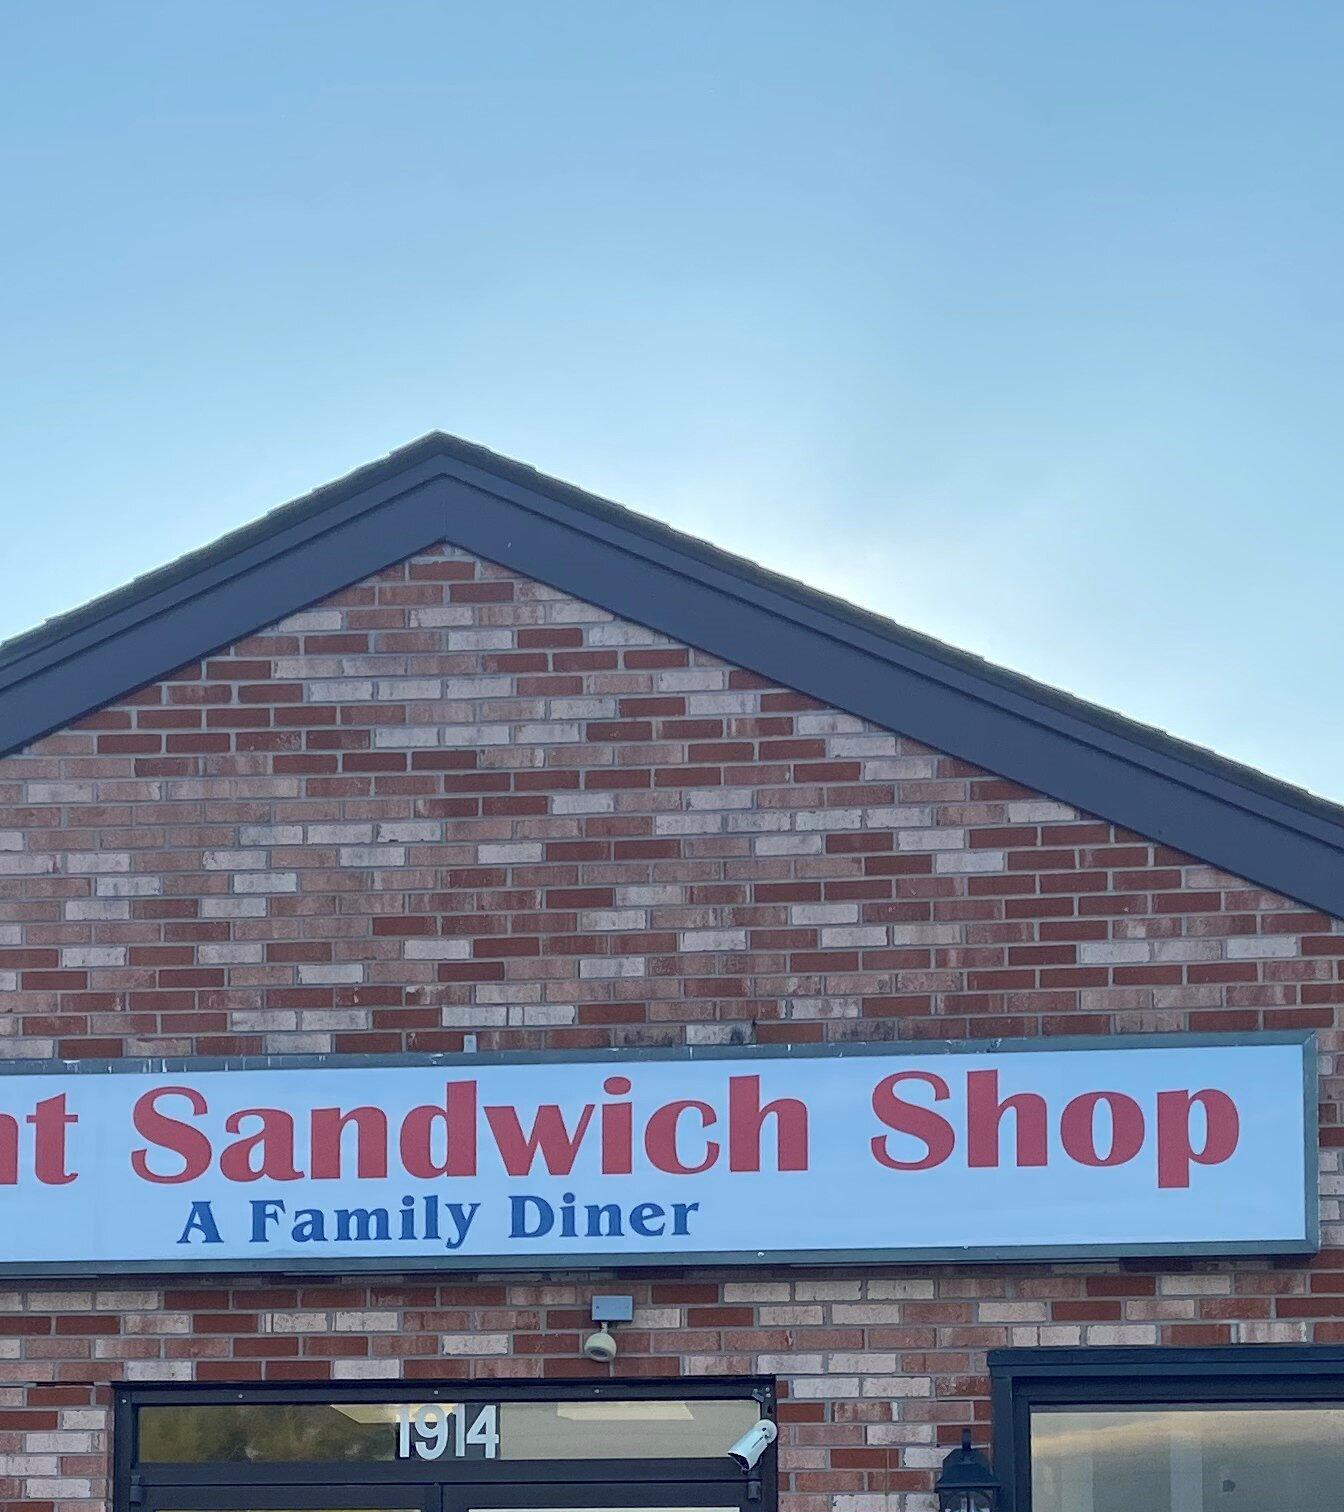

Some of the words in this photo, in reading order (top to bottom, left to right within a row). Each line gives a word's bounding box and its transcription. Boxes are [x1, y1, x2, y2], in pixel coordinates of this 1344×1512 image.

[132, 1076, 808, 1184] Sandwich
[870, 1070, 1239, 1188] Shop
[176, 1199, 224, 1244] A
[248, 1194, 482, 1250] Family
[507, 1191, 701, 1240] Diner
[399, 1403, 500, 1460] 1914
